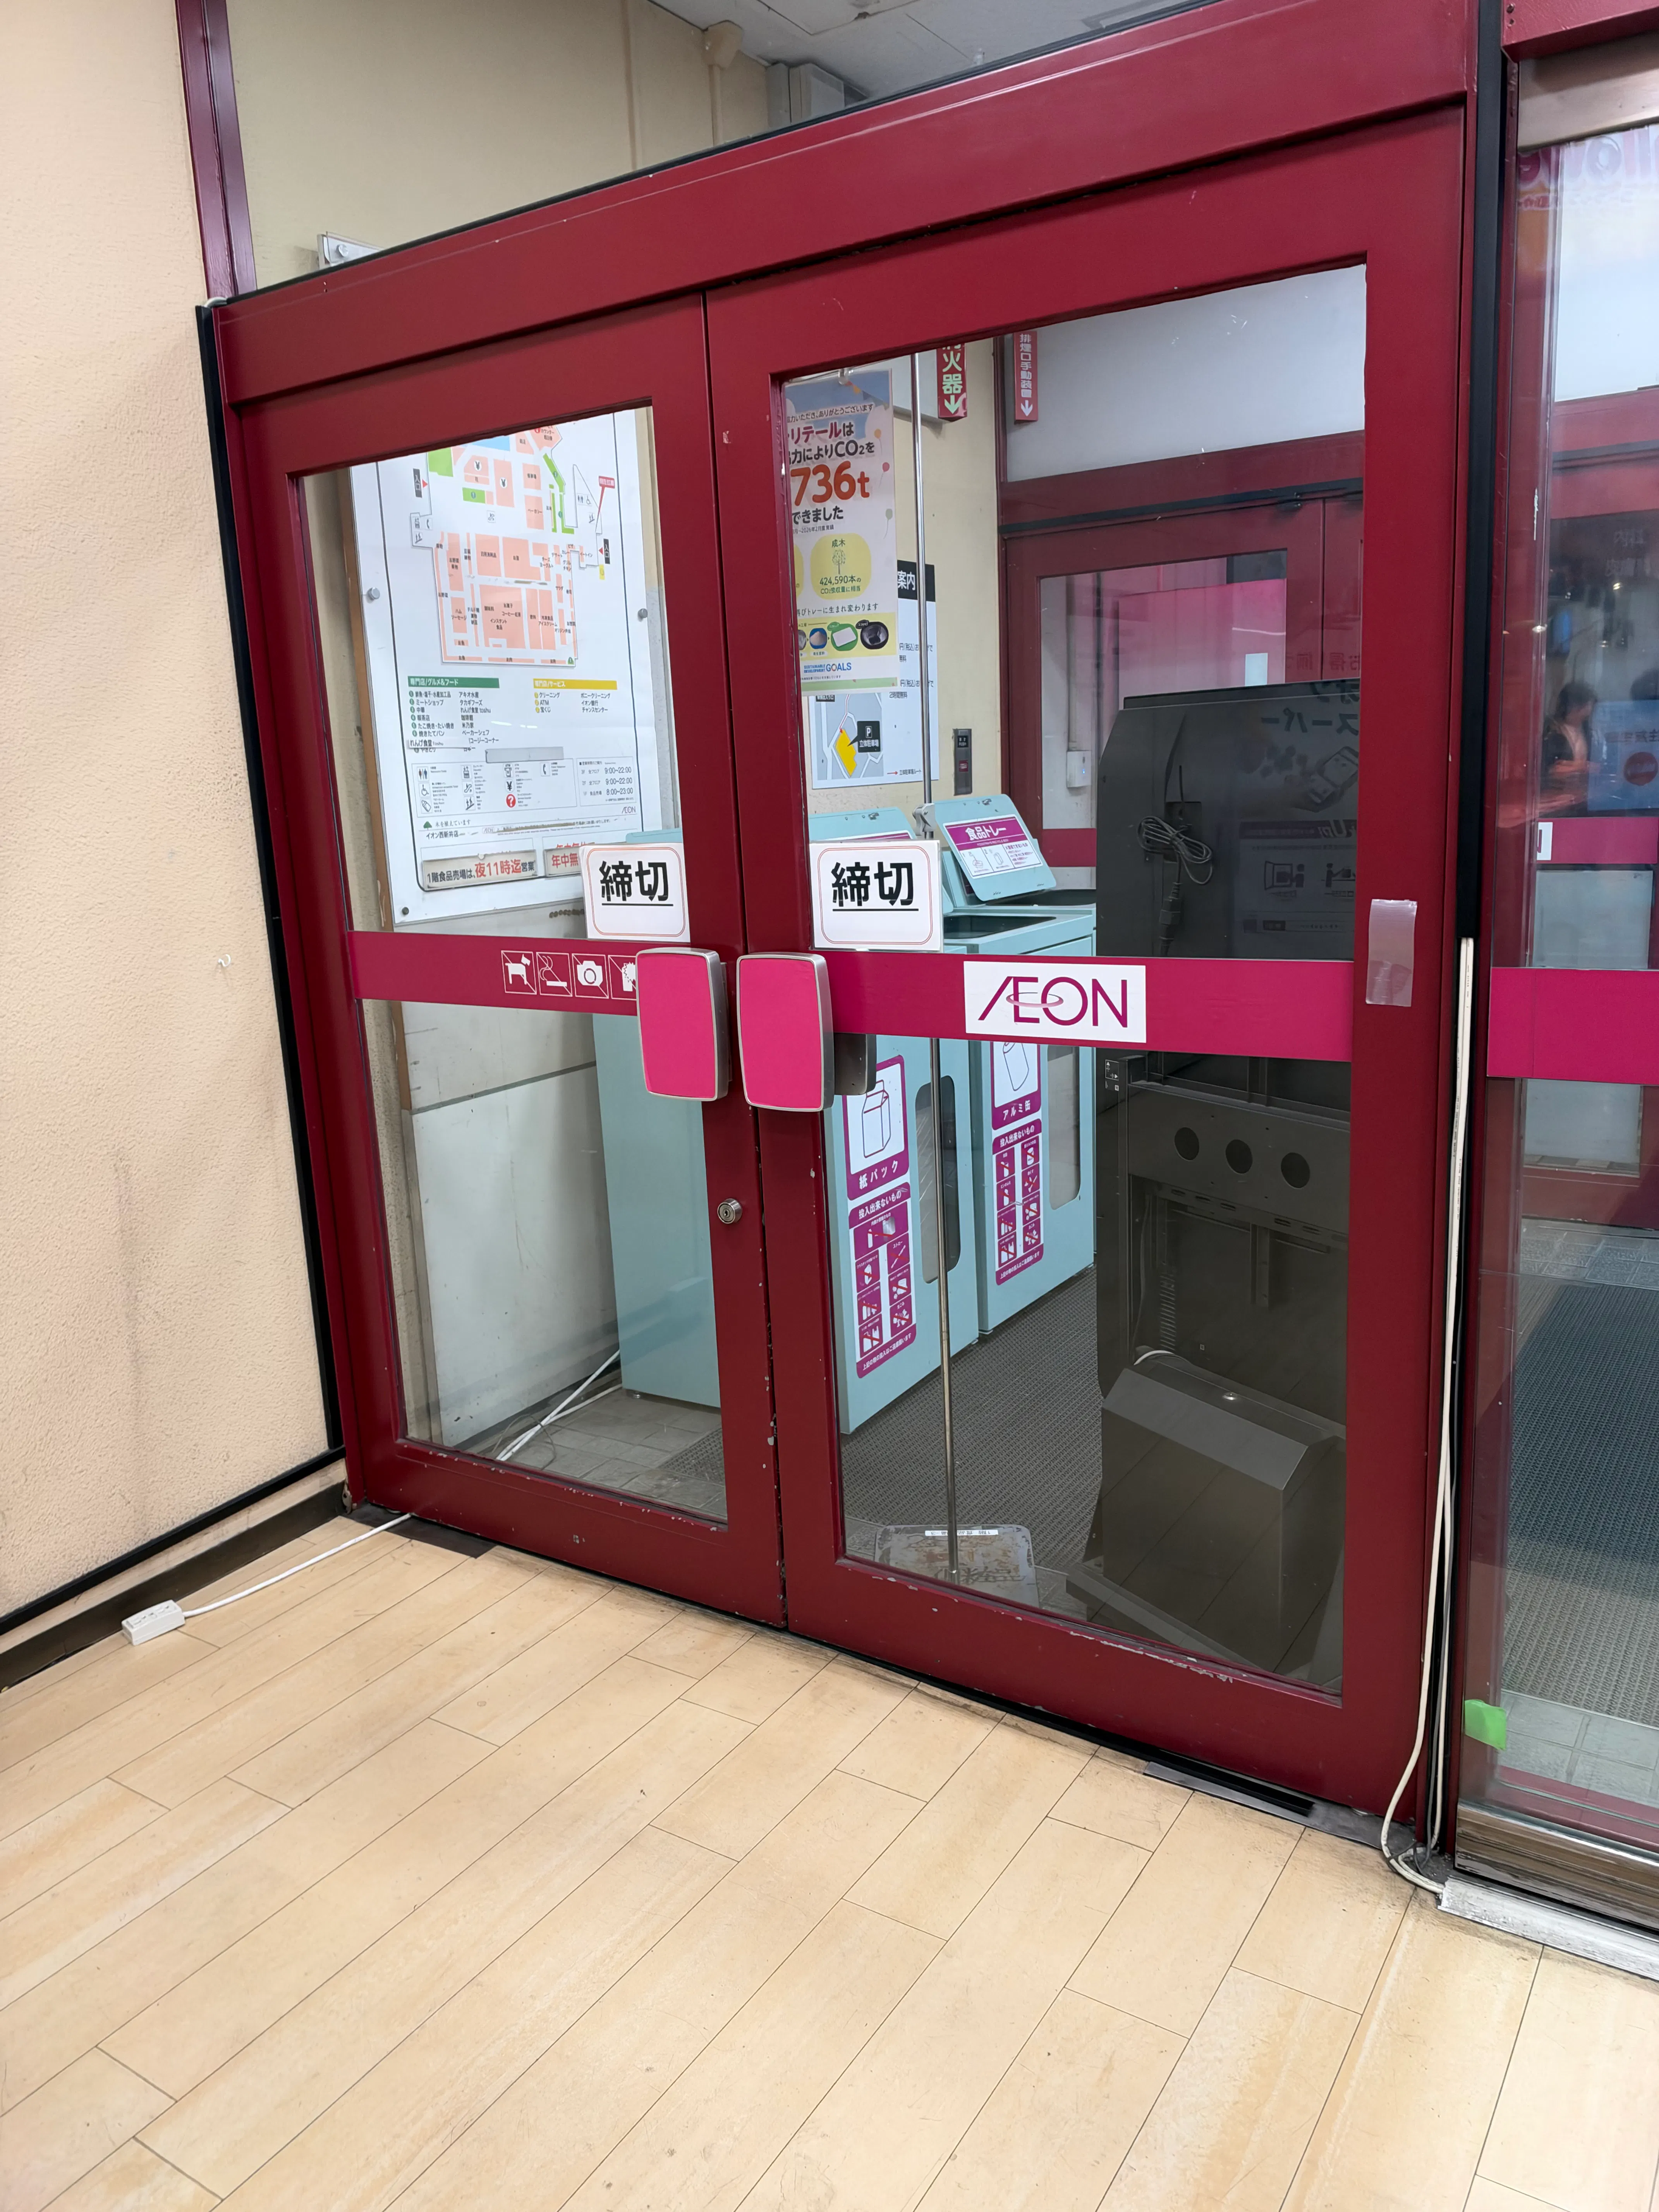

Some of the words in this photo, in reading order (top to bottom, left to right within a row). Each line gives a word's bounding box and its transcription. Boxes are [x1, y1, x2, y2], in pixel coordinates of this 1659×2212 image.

[942, 344, 963, 394] 火器
[1020, 334, 1032, 398] 排煙口手動装置
[788, 422, 854, 445] リテールは
[789, 440, 874, 465] 力によりCO2を
[414, 475, 421, 491] 入口
[792, 505, 843, 525] できました
[605, 544, 610, 558] 入口
[832, 539, 845, 548] 成木
[819, 575, 861, 586] 424,590本の
[897, 570, 915, 591] 案内
[826, 662, 852, 672] GOALS
[866, 727, 871, 737] P
[435, 819, 471, 828] 木を植えています
[965, 825, 1007, 840] 食品トレー
[426, 830, 459, 840] イオン西新井店
[427, 859, 535, 883] 1階食品売場は、夜11時迄営業
[599, 860, 669, 902] 締切
[831, 861, 914, 907] 締切
[1003, 1100, 1030, 1121] アルミ缶
[1000, 1125, 1034, 1147] 投入出来ないもの
[859, 1160, 898, 1189] 紙パック
[859, 1190, 902, 1219] 投入出来ないもの
